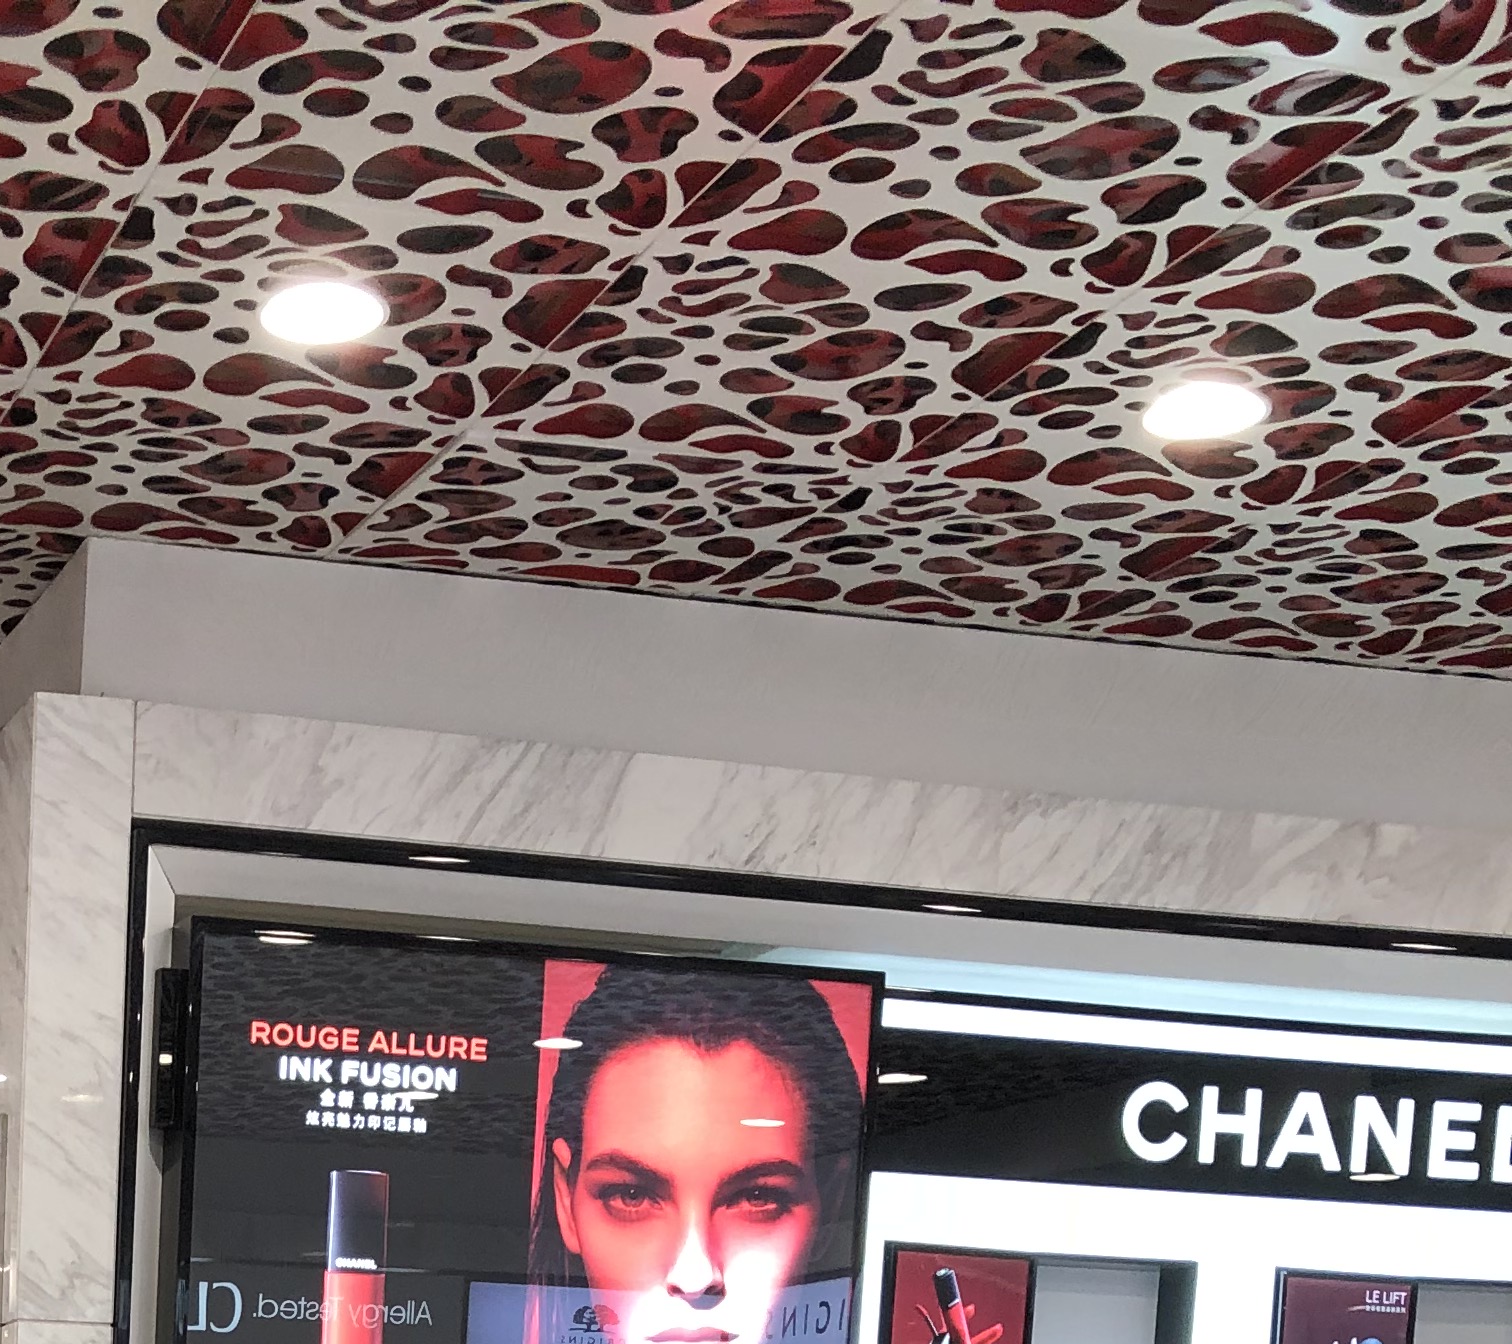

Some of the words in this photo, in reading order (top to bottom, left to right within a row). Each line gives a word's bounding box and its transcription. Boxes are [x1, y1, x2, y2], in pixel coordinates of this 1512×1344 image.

[249, 1020, 361, 1052] ROUGE
[367, 1030, 489, 1062] ALLURE
[278, 1055, 334, 1084] INK
[340, 1058, 458, 1092] FUSION
[1364, 1289, 1380, 1304] LE
[1382, 1291, 1408, 1306] LIFT
